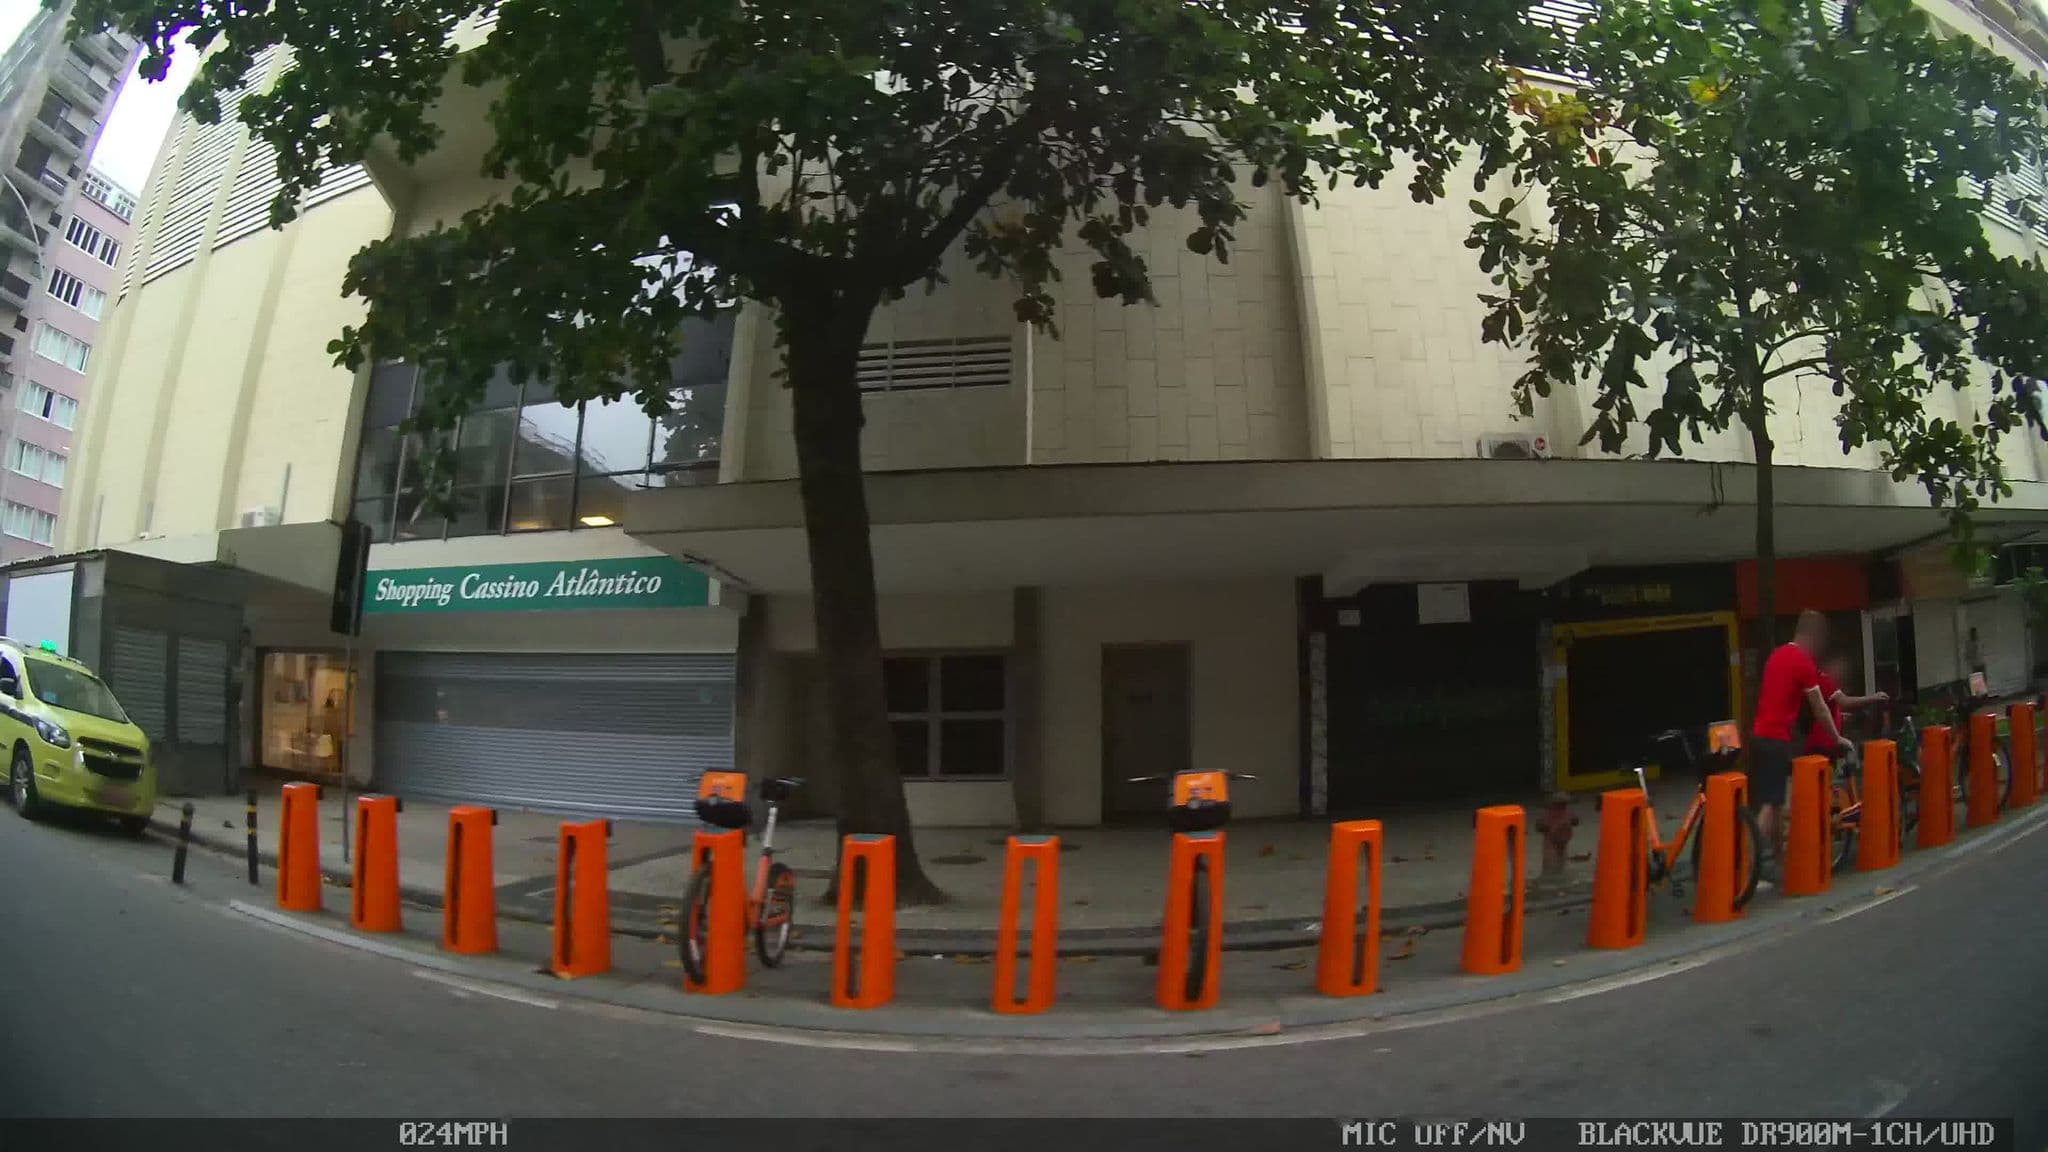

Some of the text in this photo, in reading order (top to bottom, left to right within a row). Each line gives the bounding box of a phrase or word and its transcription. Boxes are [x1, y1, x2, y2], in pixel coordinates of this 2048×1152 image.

[375, 567, 662, 607] Shopping Cassino Atlântico
